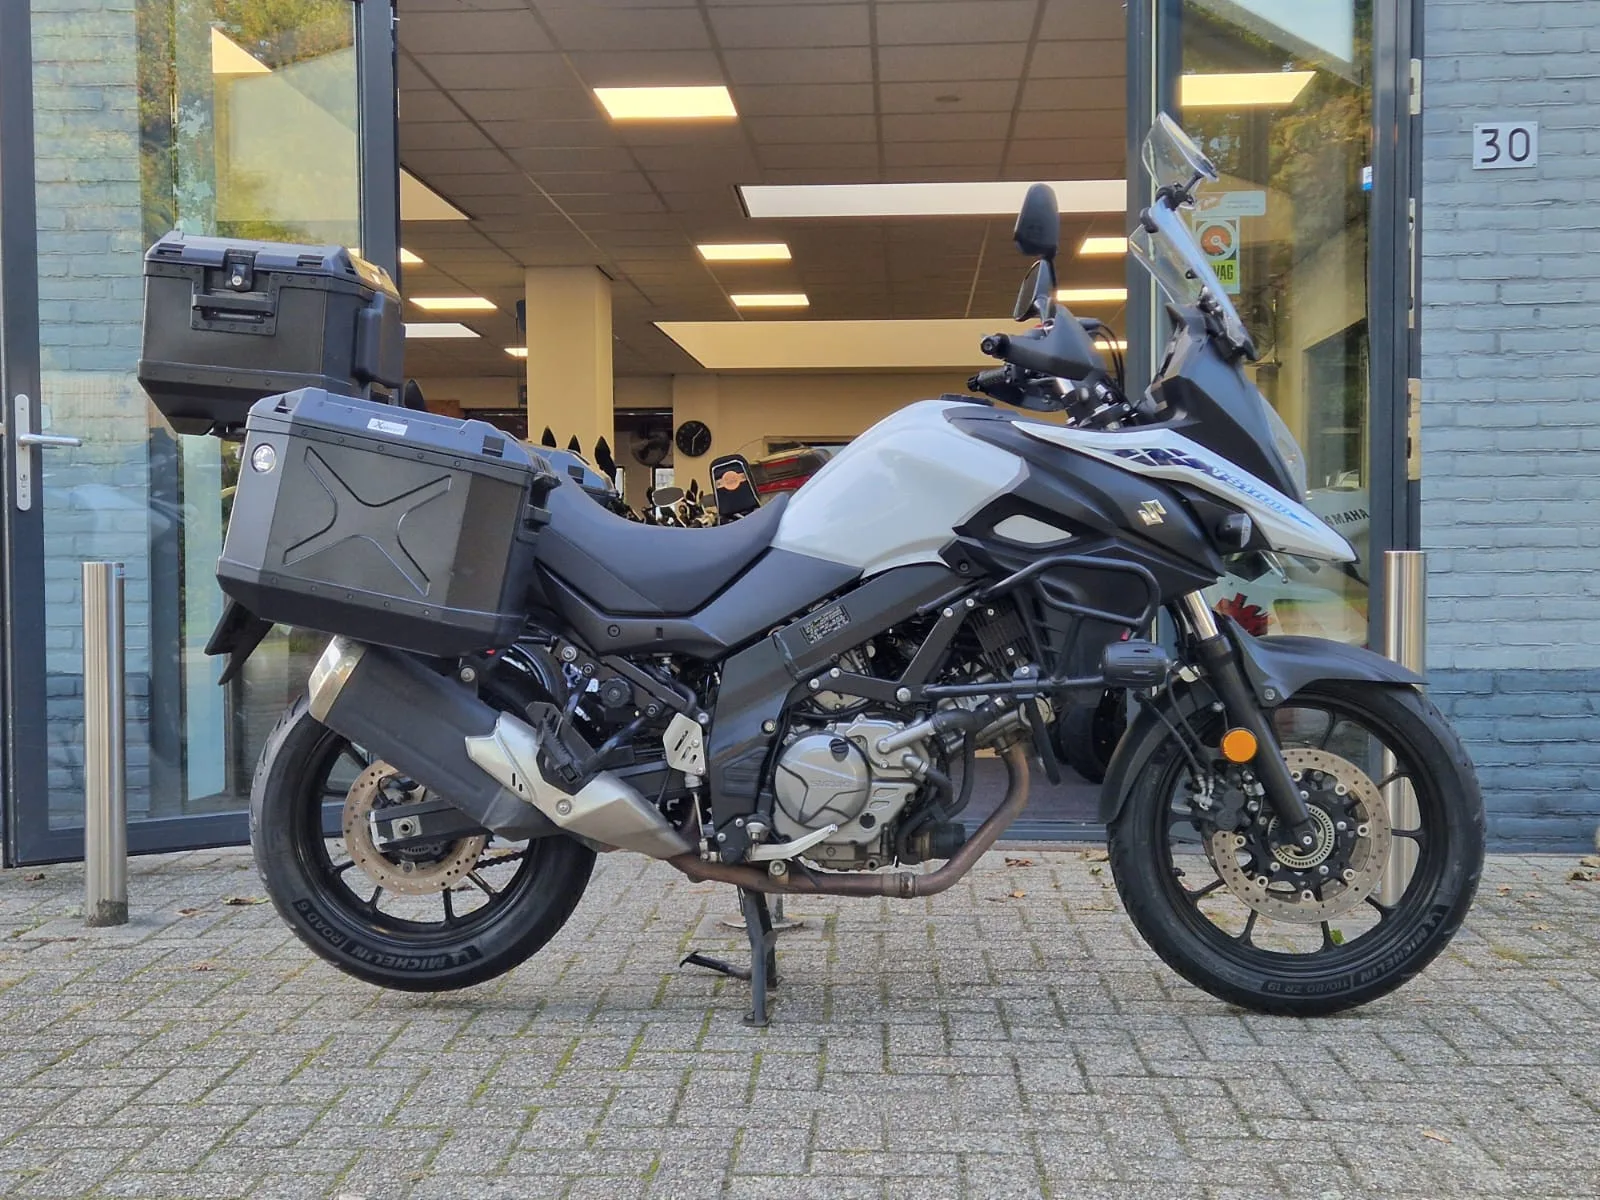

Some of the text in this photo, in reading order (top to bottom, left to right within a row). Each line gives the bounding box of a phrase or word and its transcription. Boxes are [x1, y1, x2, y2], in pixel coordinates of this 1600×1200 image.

[1481, 127, 1530, 163] 30
[1213, 264, 1234, 280] VAG
[1323, 508, 1370, 526] AMAHA
[306, 911, 343, 945] ROAD
[350, 942, 447, 970] MICHELIN
[1360, 926, 1428, 983] MICHELIN
